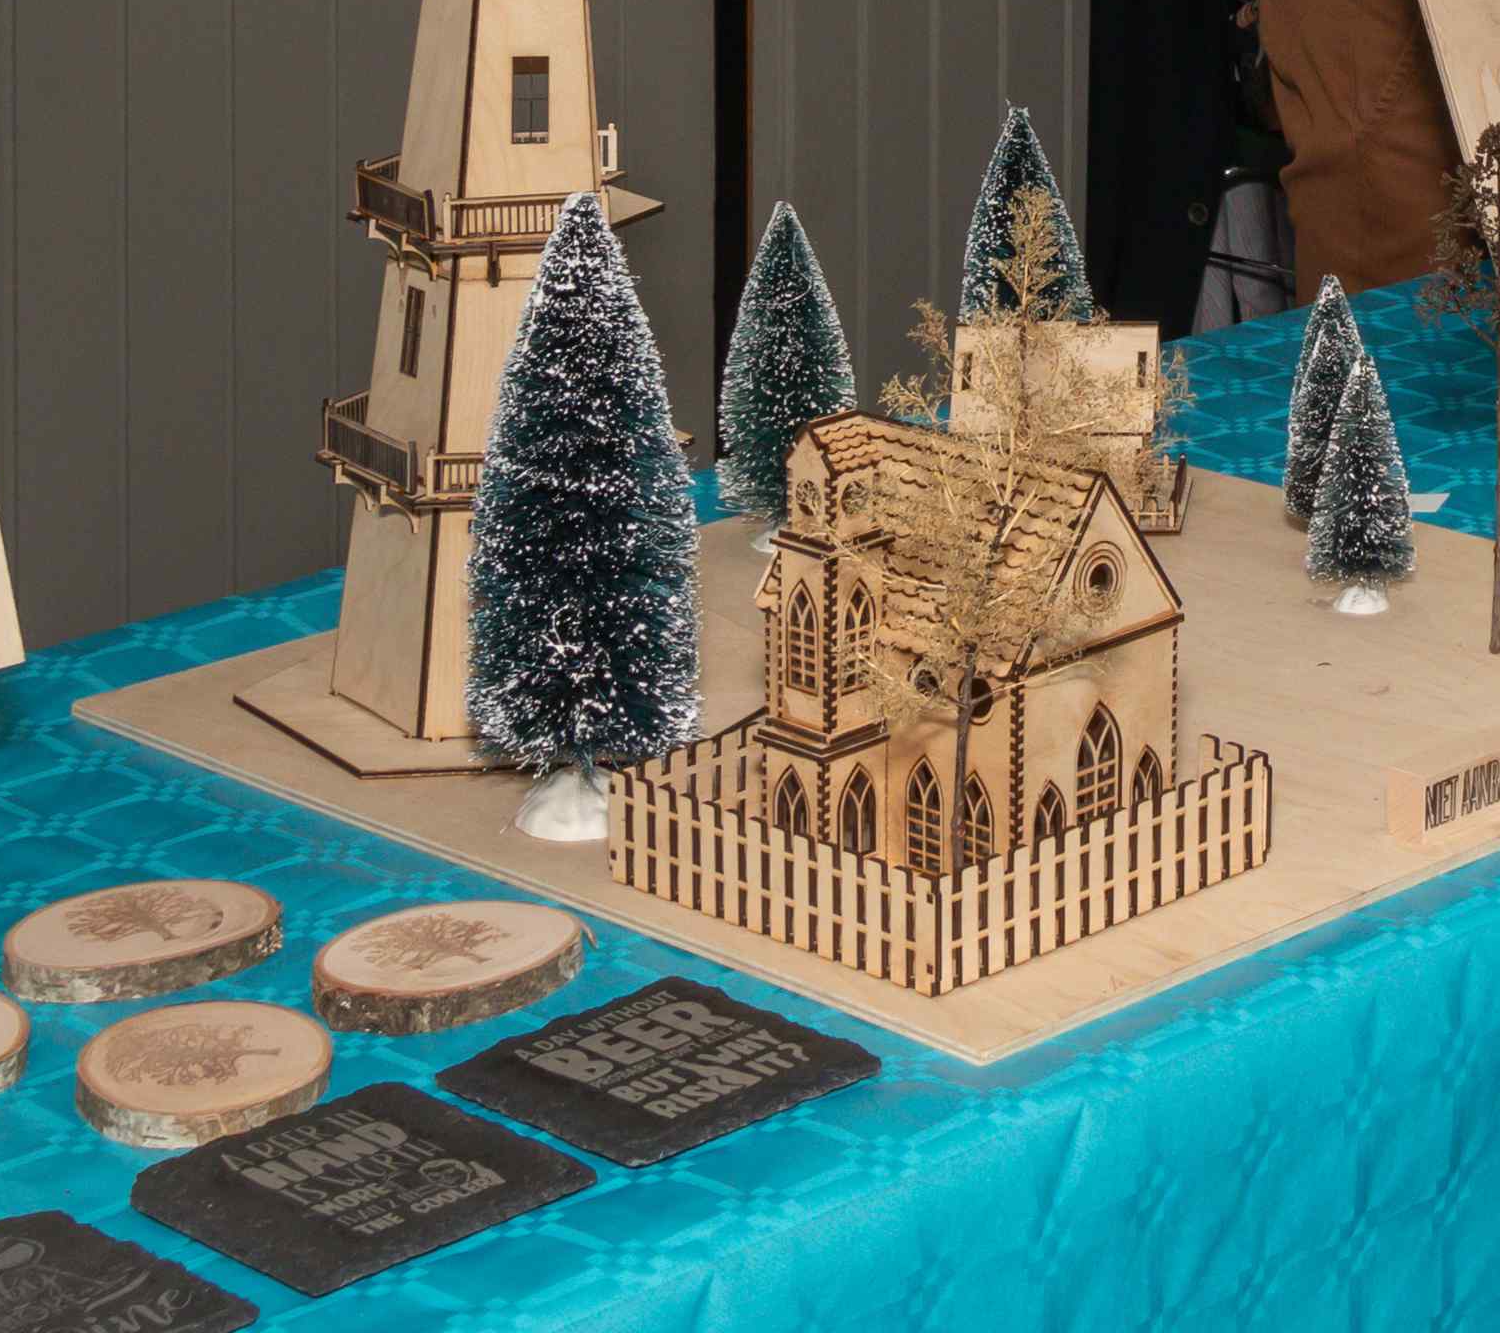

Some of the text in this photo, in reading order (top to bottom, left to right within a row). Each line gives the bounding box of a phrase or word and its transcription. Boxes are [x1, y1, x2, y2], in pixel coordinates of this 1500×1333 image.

[1425, 773, 1460, 832] NIET
[514, 989, 680, 1063] A DAY WITHOUT
[528, 1000, 737, 1084] BEER
[607, 1028, 787, 1105] BUT WHY
[642, 1041, 811, 1121] RISK IT?
[219, 1151, 255, 1172] A
[245, 1123, 329, 1161] BEER
[240, 1120, 410, 1192] HAND
[276, 1137, 446, 1207] IS WORTH
[309, 1180, 391, 1217] MORE
[350, 1210, 406, 1235] THE
